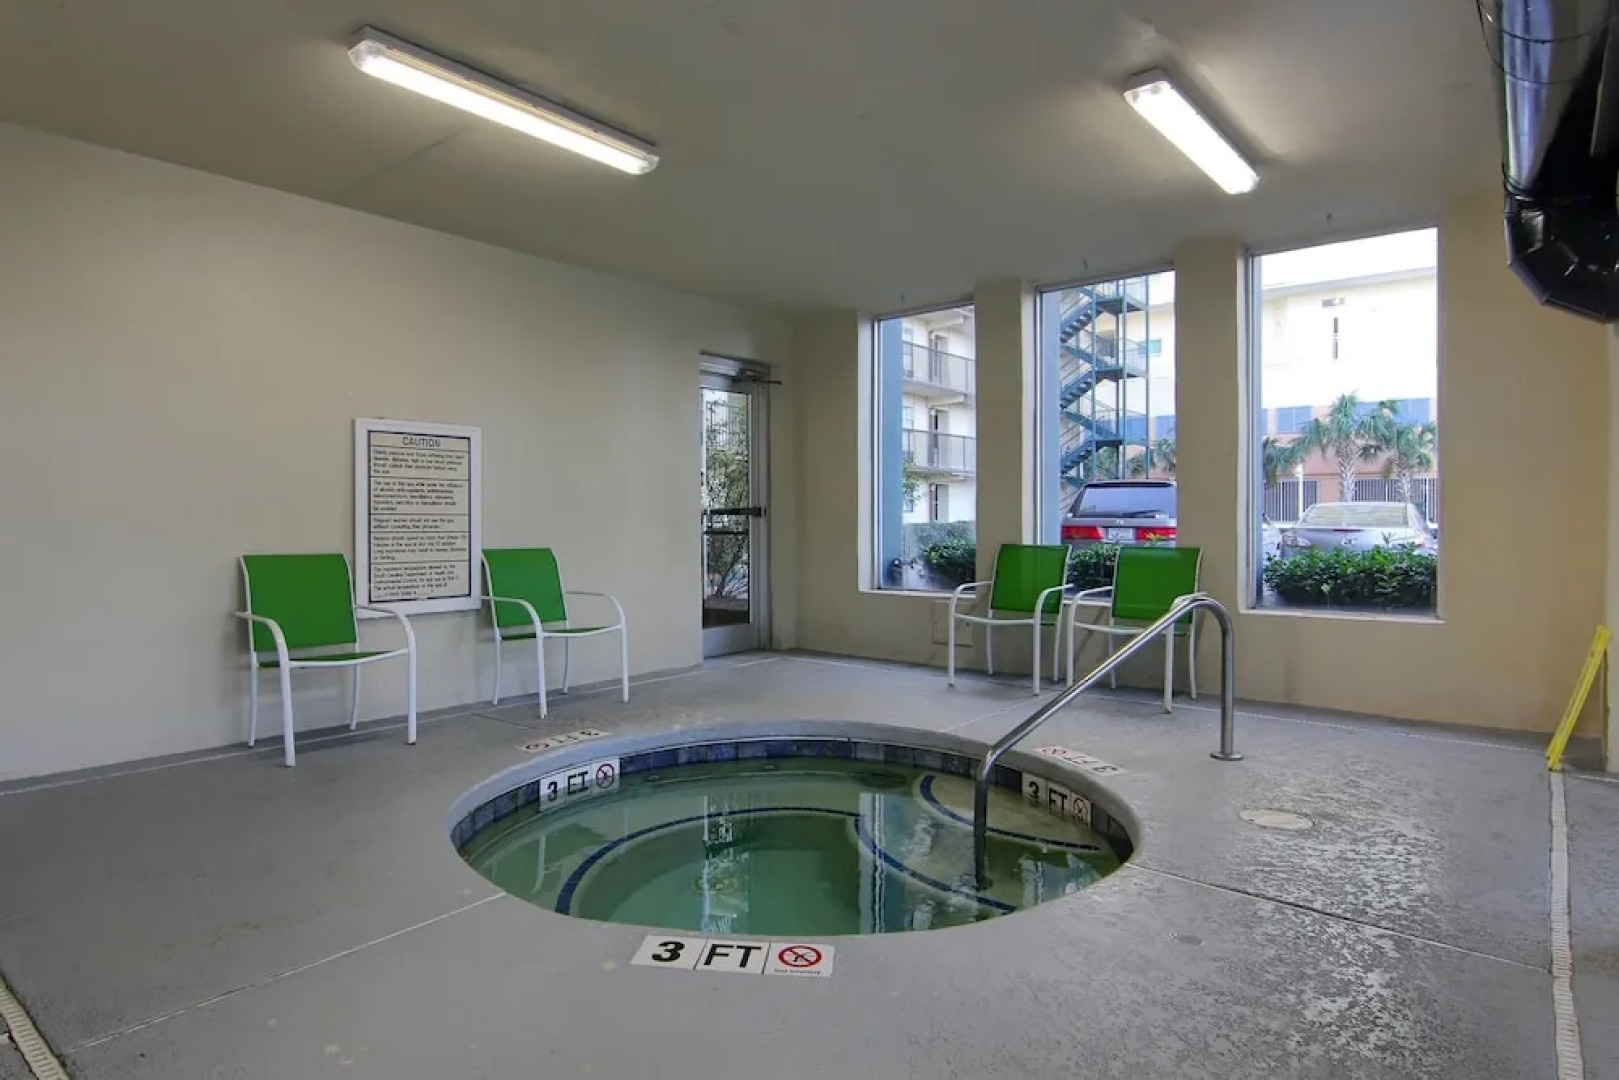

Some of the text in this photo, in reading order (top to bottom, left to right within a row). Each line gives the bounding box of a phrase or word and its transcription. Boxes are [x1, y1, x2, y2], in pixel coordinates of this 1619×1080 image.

[402, 436, 441, 447] CAUTION
[651, 941, 762, 968] 3 FT
